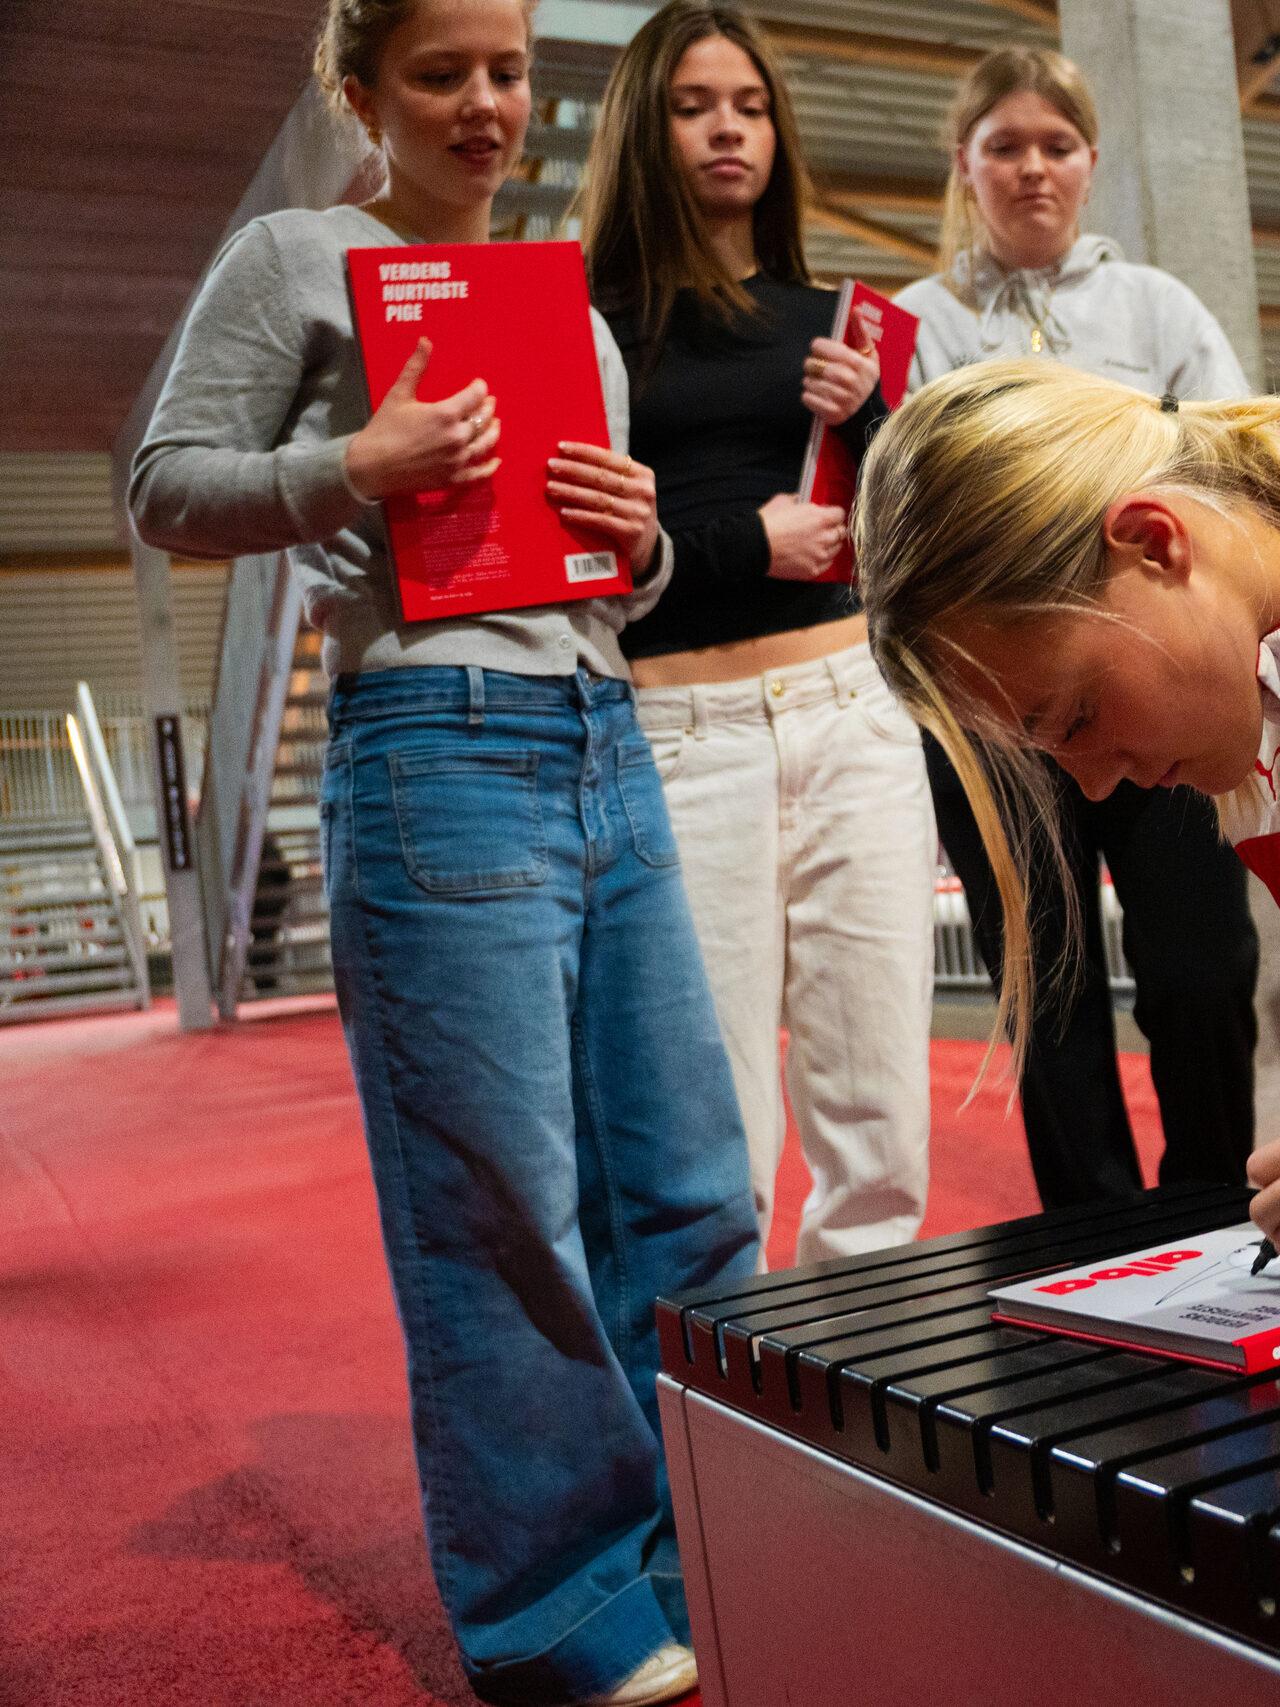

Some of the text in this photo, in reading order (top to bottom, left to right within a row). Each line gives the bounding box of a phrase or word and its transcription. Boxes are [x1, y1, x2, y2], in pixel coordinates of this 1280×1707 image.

[379, 261, 452, 281] VERDENS
[382, 281, 469, 302] HURTIGSTE
[385, 303, 423, 323] PIGE
[1033, 1249, 1203, 1295] alba
